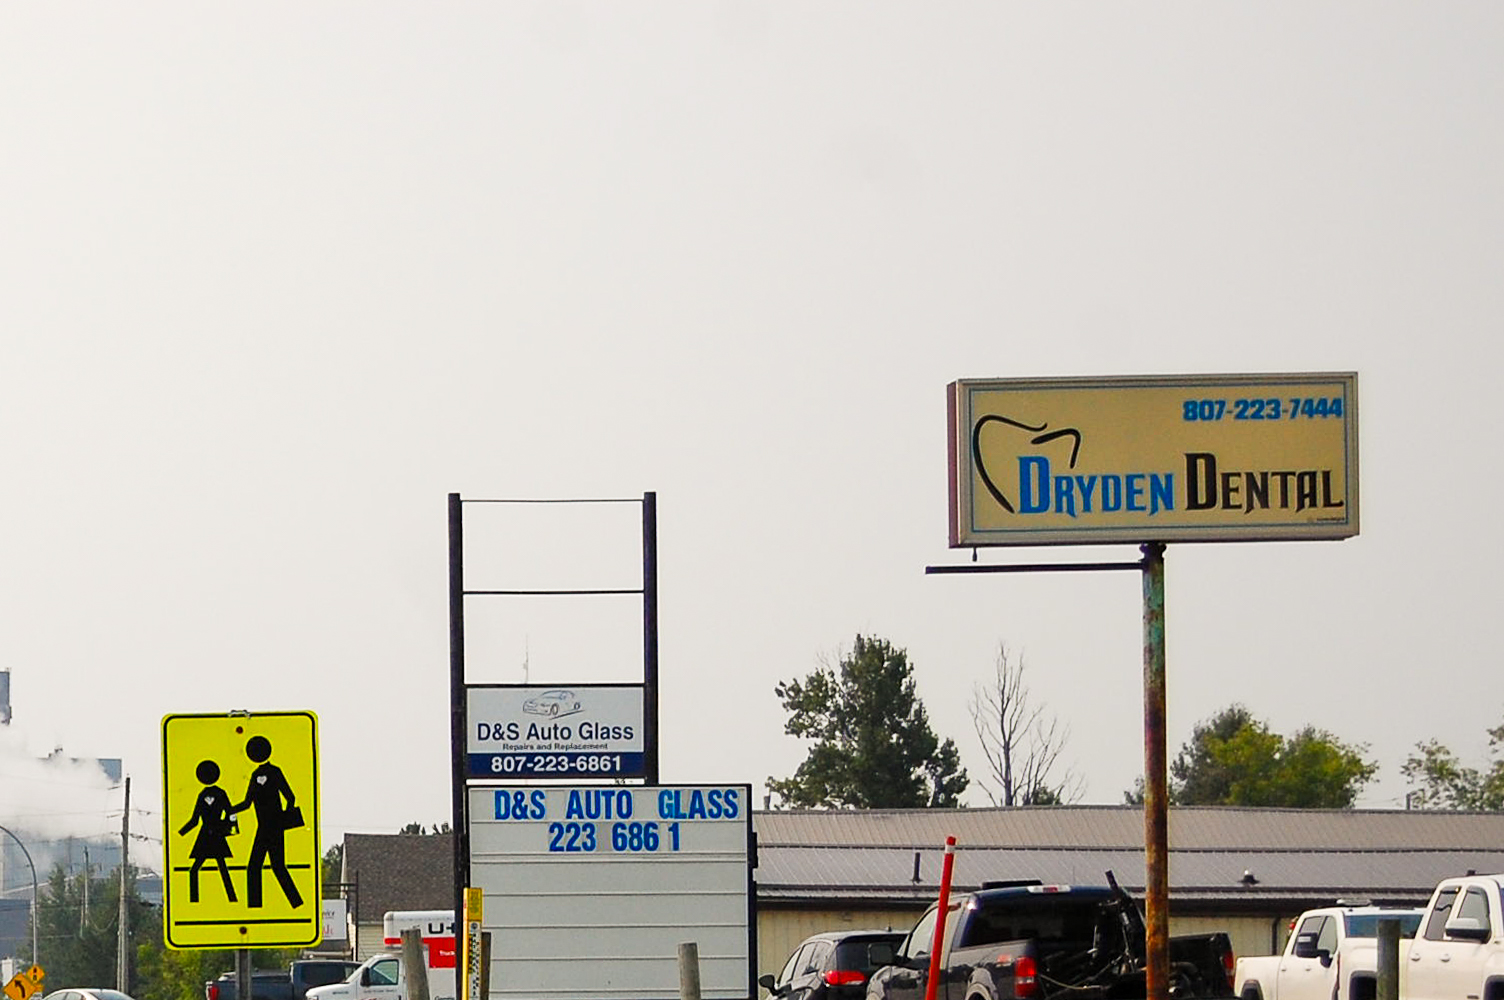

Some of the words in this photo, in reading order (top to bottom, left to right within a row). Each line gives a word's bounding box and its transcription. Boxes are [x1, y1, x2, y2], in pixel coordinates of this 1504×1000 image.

[1182, 398, 1343, 421] 807-223-7444
[477, 722, 520, 740] D&S
[526, 722, 572, 740] Auto
[578, 722, 634, 740] Glass
[502, 743, 534, 751] Repairs
[554, 743, 608, 751] Replacement
[491, 756, 621, 772] 807-223-6861
[495, 790, 546, 820] D&S
[565, 790, 633, 820] AUTO
[657, 789, 739, 820] GLASS
[549, 823, 596, 852] 223
